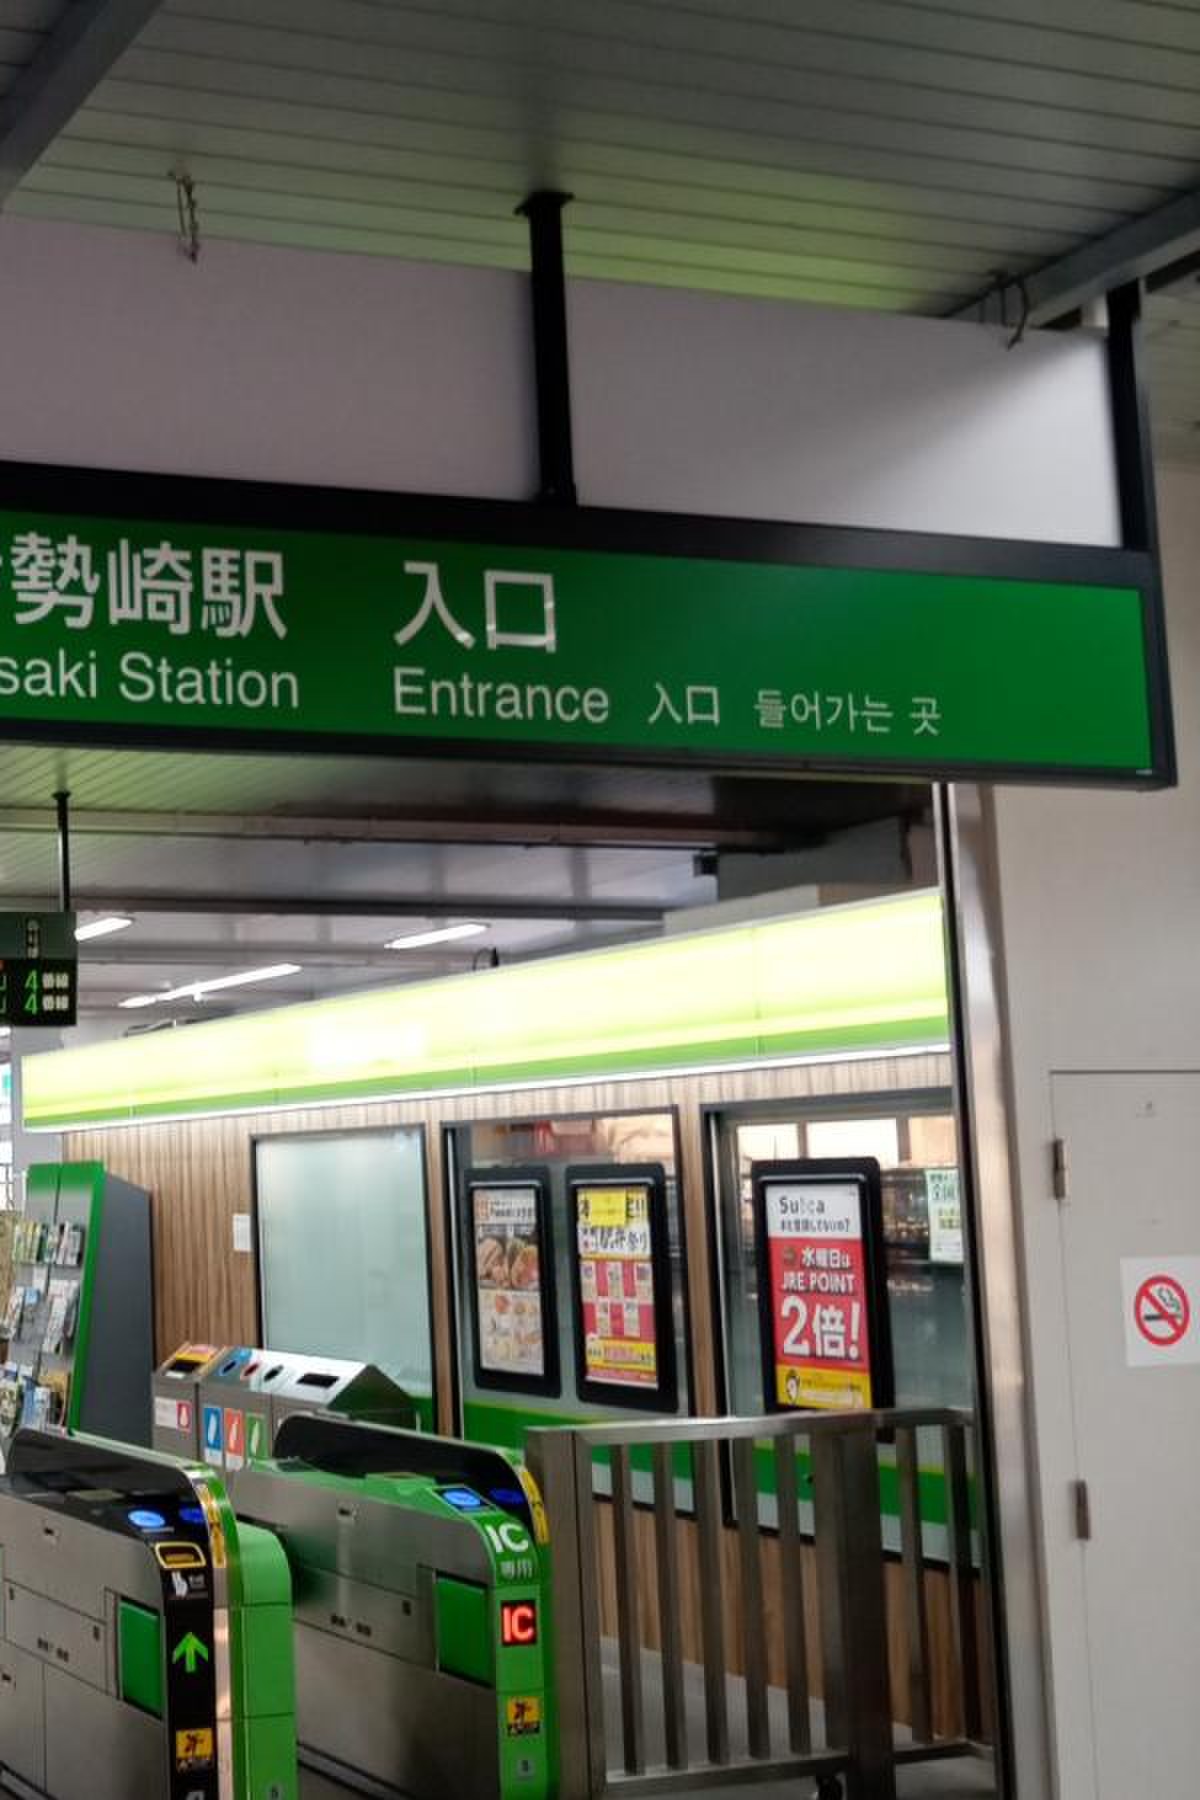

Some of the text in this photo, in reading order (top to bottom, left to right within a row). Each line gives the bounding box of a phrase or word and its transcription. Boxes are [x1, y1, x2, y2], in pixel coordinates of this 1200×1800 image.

[394, 560, 556, 653] 入口
[119, 652, 299, 709] Station
[393, 665, 610, 723] Entrance
[648, 683, 720, 725] 入口
[754, 688, 942, 737] 들어가는 곳
[25, 970, 38, 991] 4
[25, 993, 38, 1014] 4
[809, 1271, 856, 1295] POINT
[781, 1295, 861, 1361] 2倍!
[485, 1523, 529, 1553] IC
[502, 1606, 534, 1644] IC
